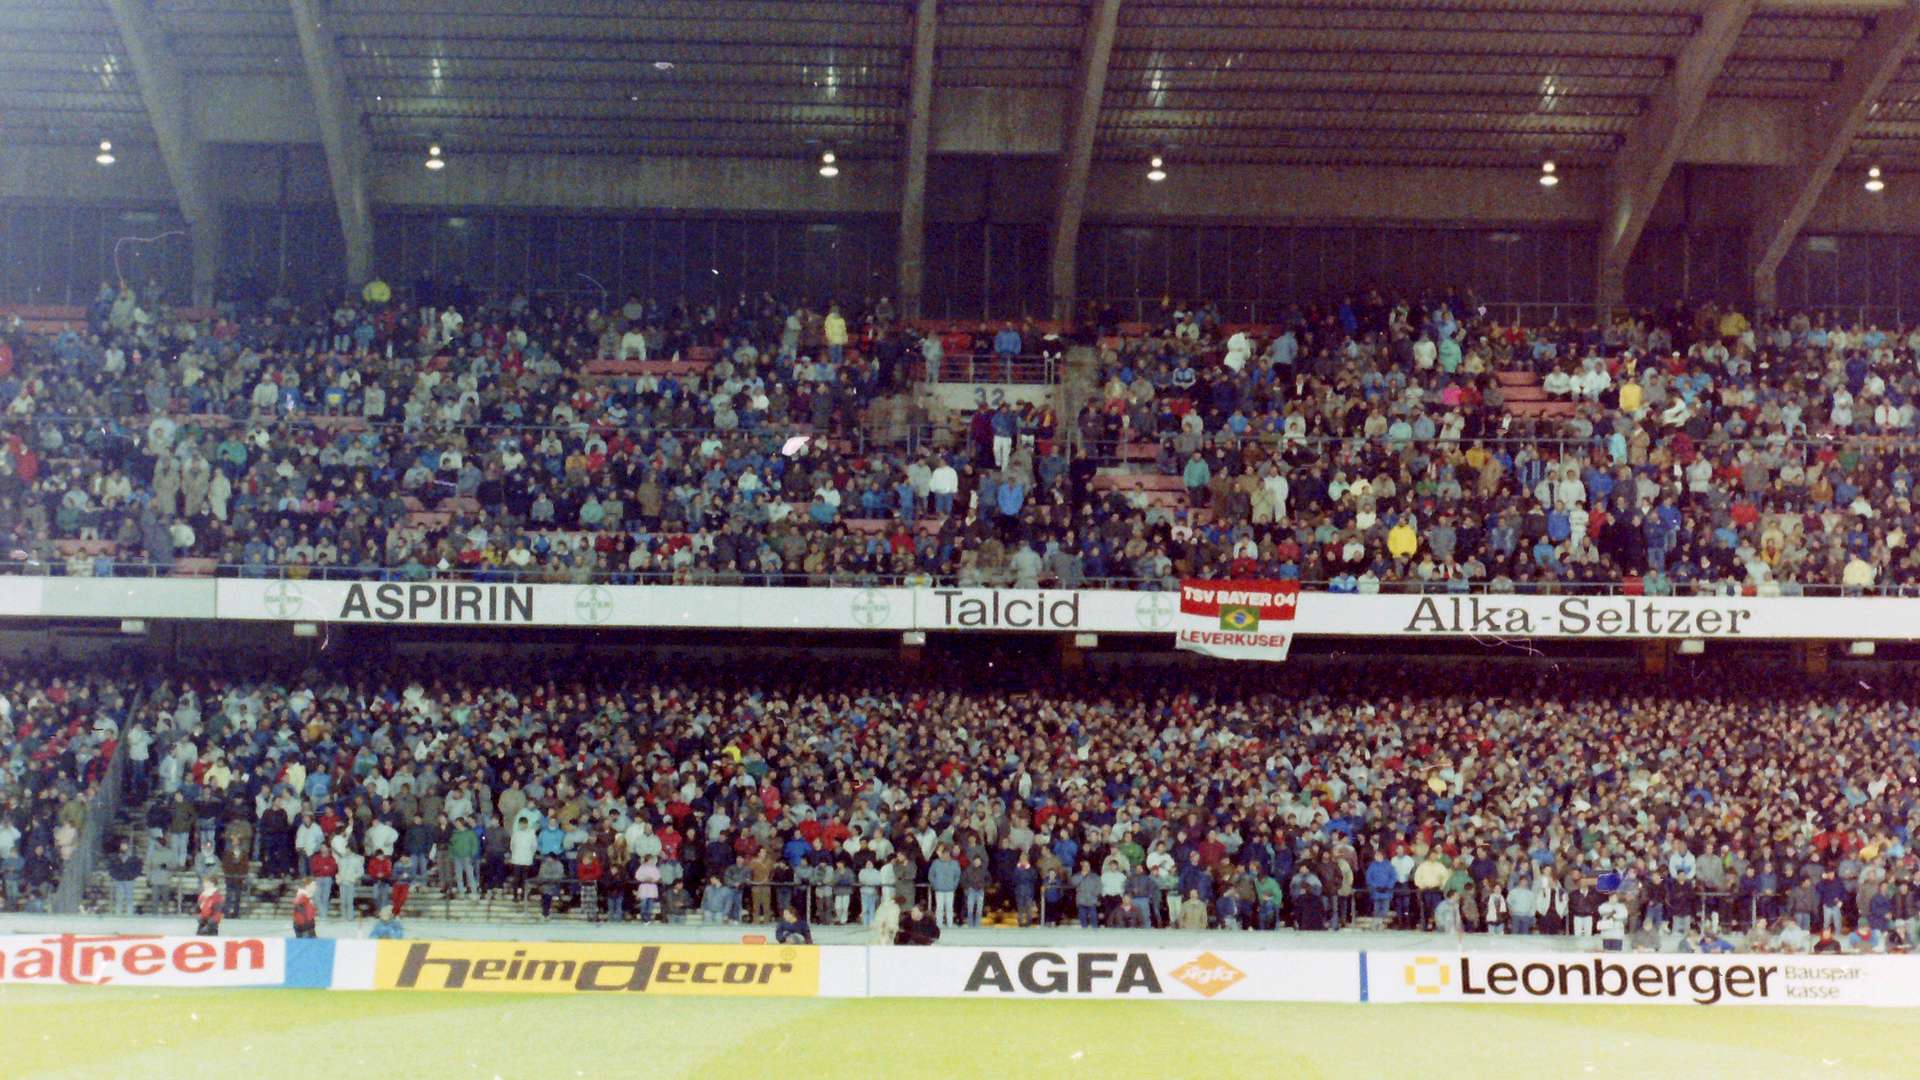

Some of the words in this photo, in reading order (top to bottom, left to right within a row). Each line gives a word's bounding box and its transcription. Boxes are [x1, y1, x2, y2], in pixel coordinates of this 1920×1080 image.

[339, 583, 534, 621] ASPIRIN
[934, 590, 1079, 627] Talcid
[1183, 586, 1215, 604] TSV
[1216, 590, 1272, 607] BAYER
[1273, 592, 1296, 607] 04
[1403, 596, 1752, 635] Alka-Seltzer
[395, 943, 792, 992] heimdecor
[964, 951, 1163, 994] AGFA
[1460, 957, 1778, 1005] Leonberger
[1785, 984, 1840, 999] kasse
